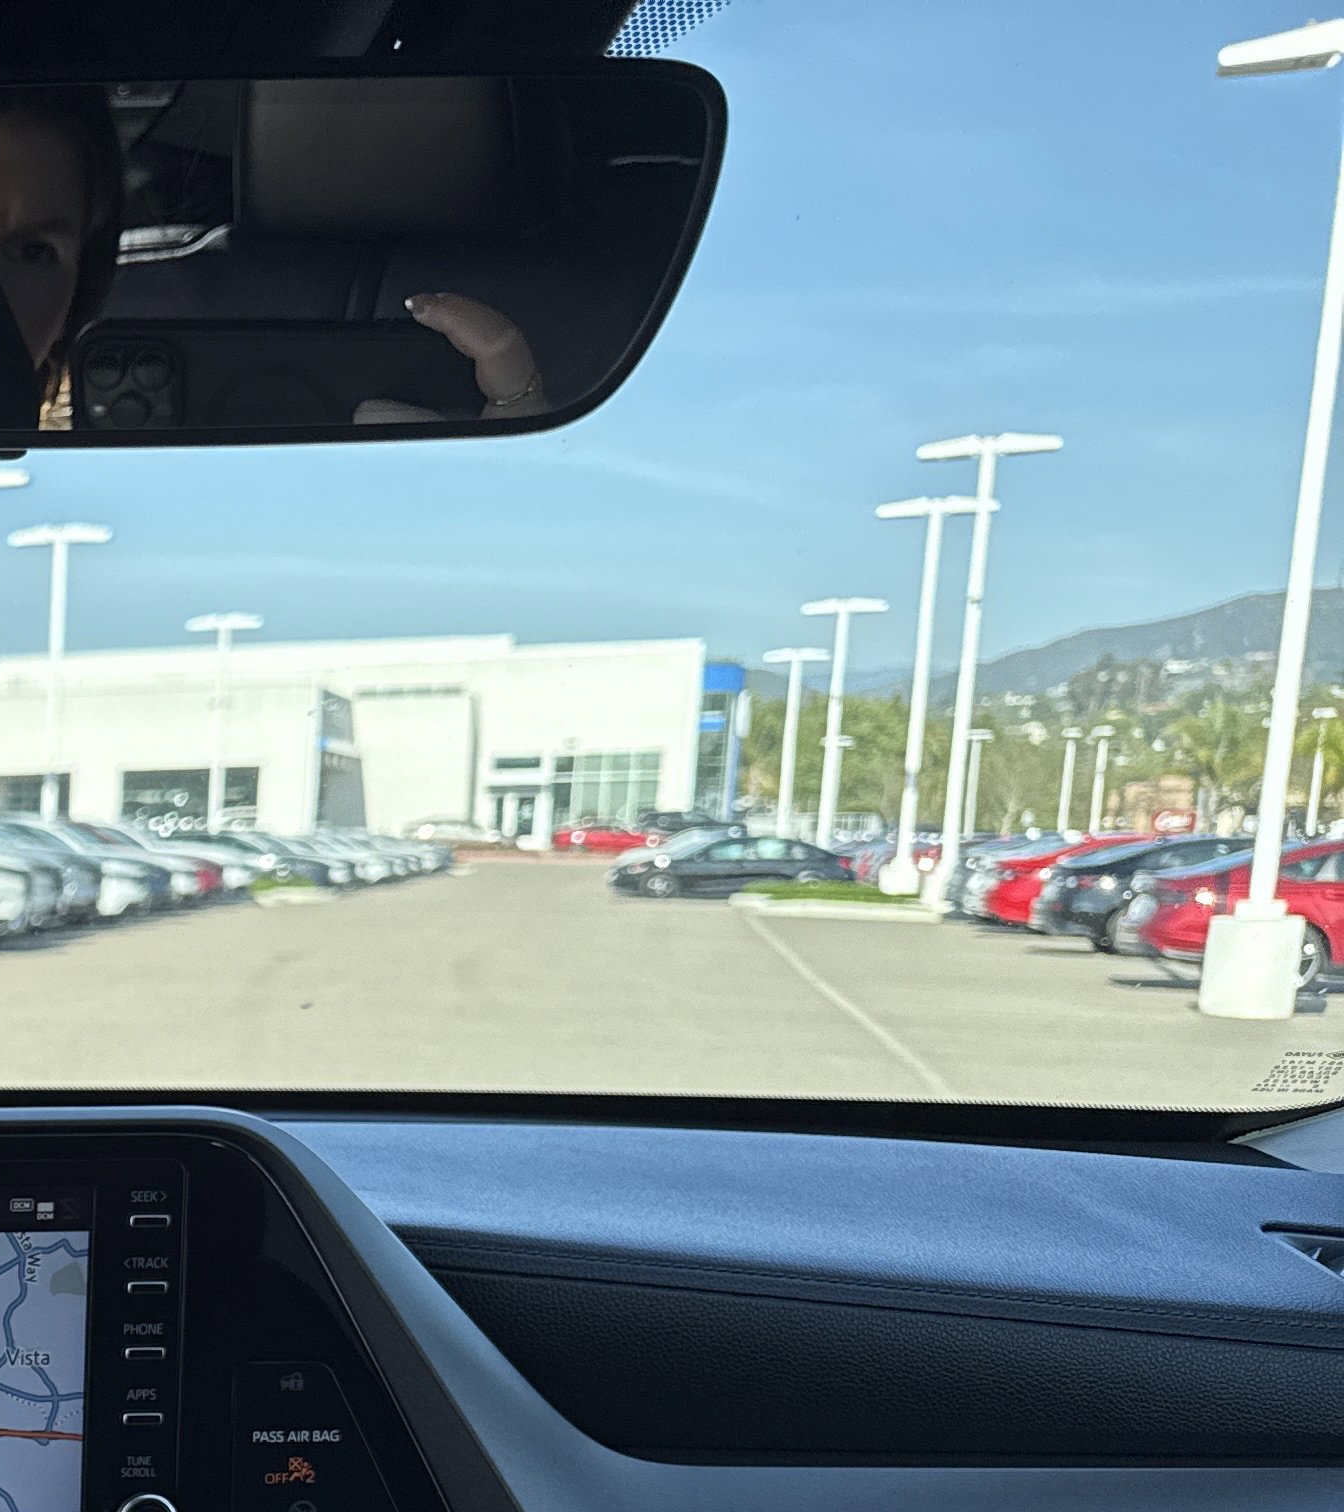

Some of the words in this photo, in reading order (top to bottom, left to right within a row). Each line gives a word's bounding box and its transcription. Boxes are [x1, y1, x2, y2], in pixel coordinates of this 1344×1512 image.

[123, 1322, 164, 1336] PHONE
[6, 1349, 50, 1367] Vista
[126, 1388, 157, 1402] APPS
[252, 1430, 284, 1443] PASS
[287, 1430, 310, 1443] AIR
[312, 1429, 341, 1443] BAG
[126, 1455, 152, 1467] TUNE
[121, 1467, 157, 1478] SCROLL
[264, 1472, 289, 1485] OFF
